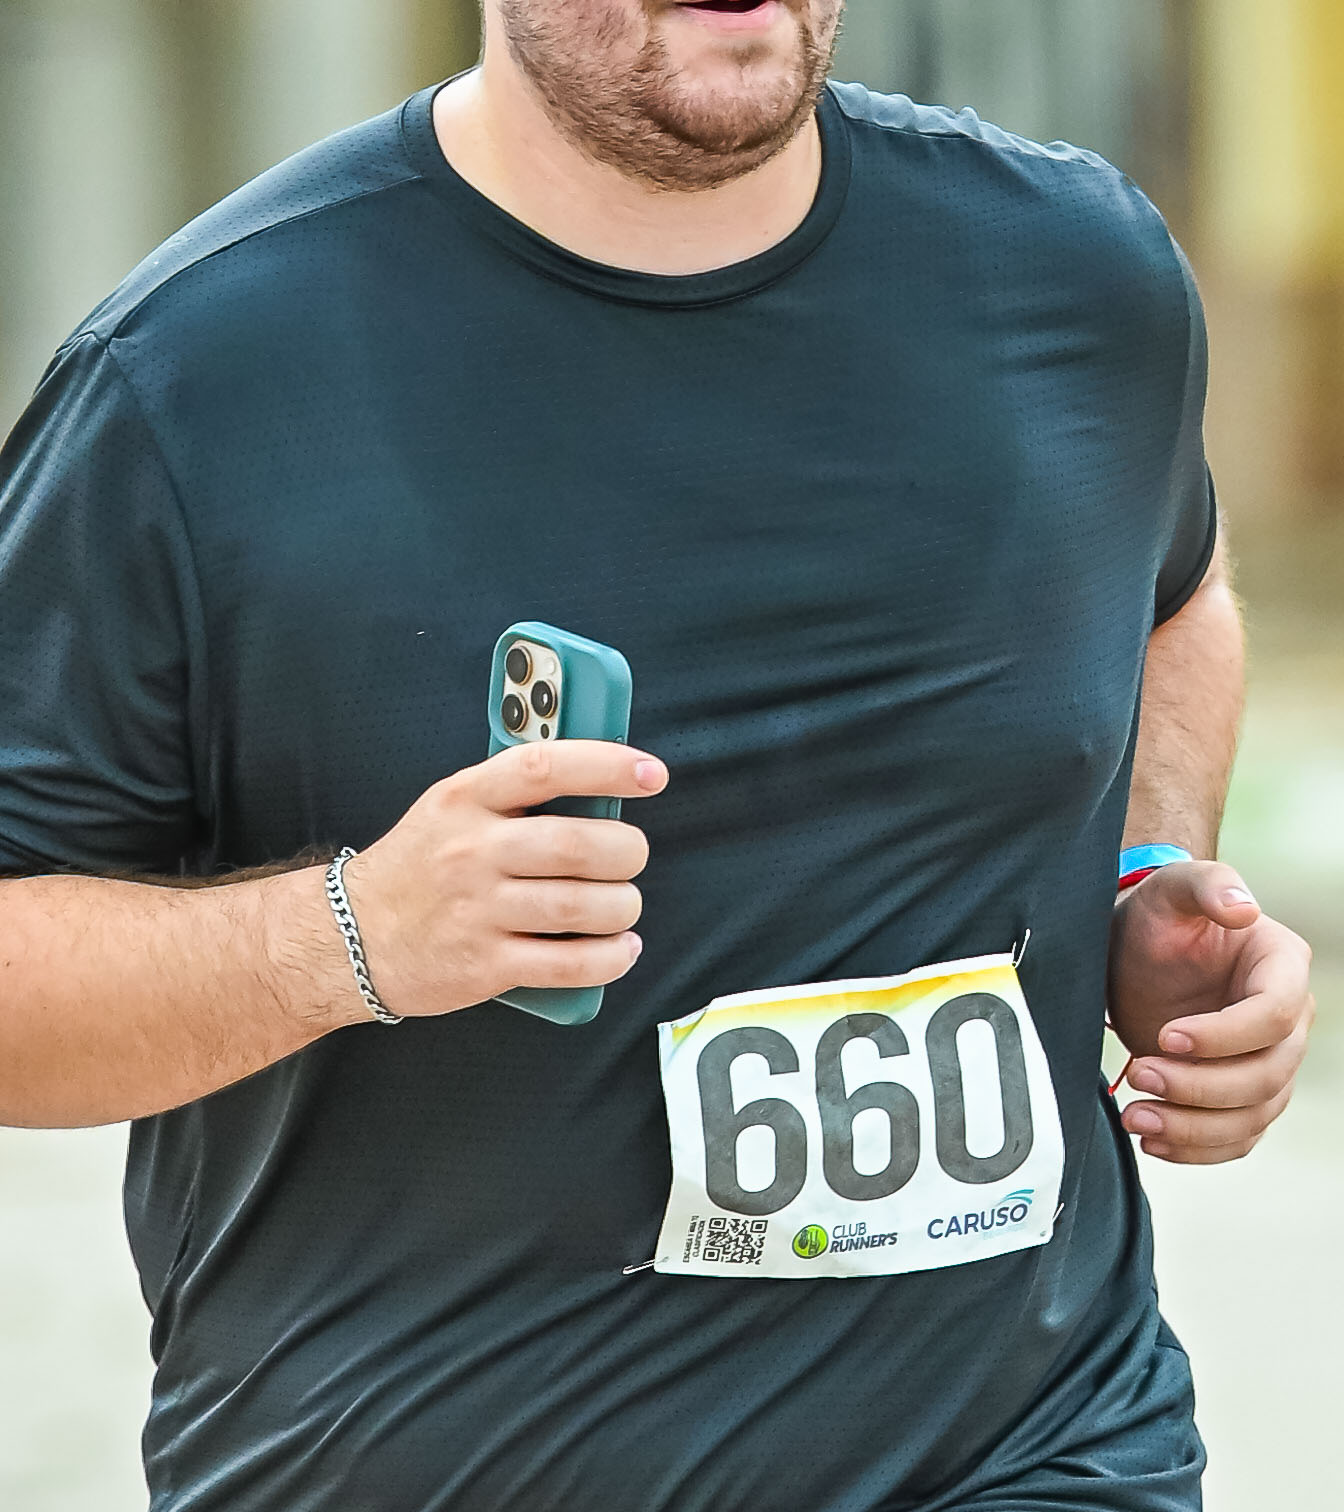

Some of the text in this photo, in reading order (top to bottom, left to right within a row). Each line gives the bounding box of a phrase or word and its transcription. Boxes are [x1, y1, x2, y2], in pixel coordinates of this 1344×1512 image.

[696, 992, 1034, 1216] 660
[832, 1222, 867, 1239] CLUB
[927, 1203, 1028, 1239] CARUSO
[829, 1232, 898, 1253] RUNNER'S
